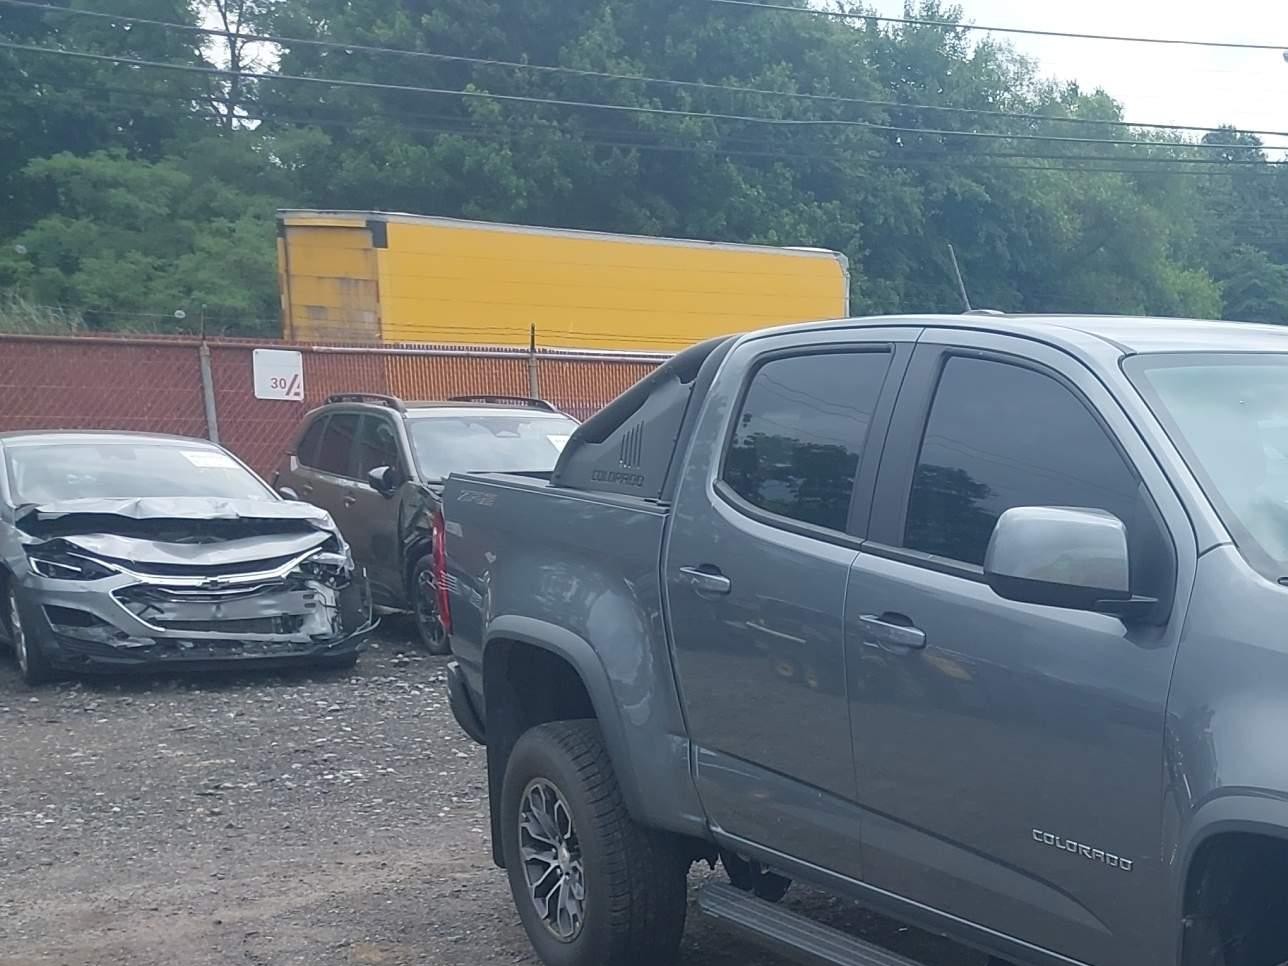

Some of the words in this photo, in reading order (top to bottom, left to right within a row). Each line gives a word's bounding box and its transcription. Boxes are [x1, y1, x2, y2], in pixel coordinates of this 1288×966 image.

[270, 377, 287, 389] 30
[592, 470, 645, 487] COLORADO
[1032, 828, 1133, 872] COLORADO
